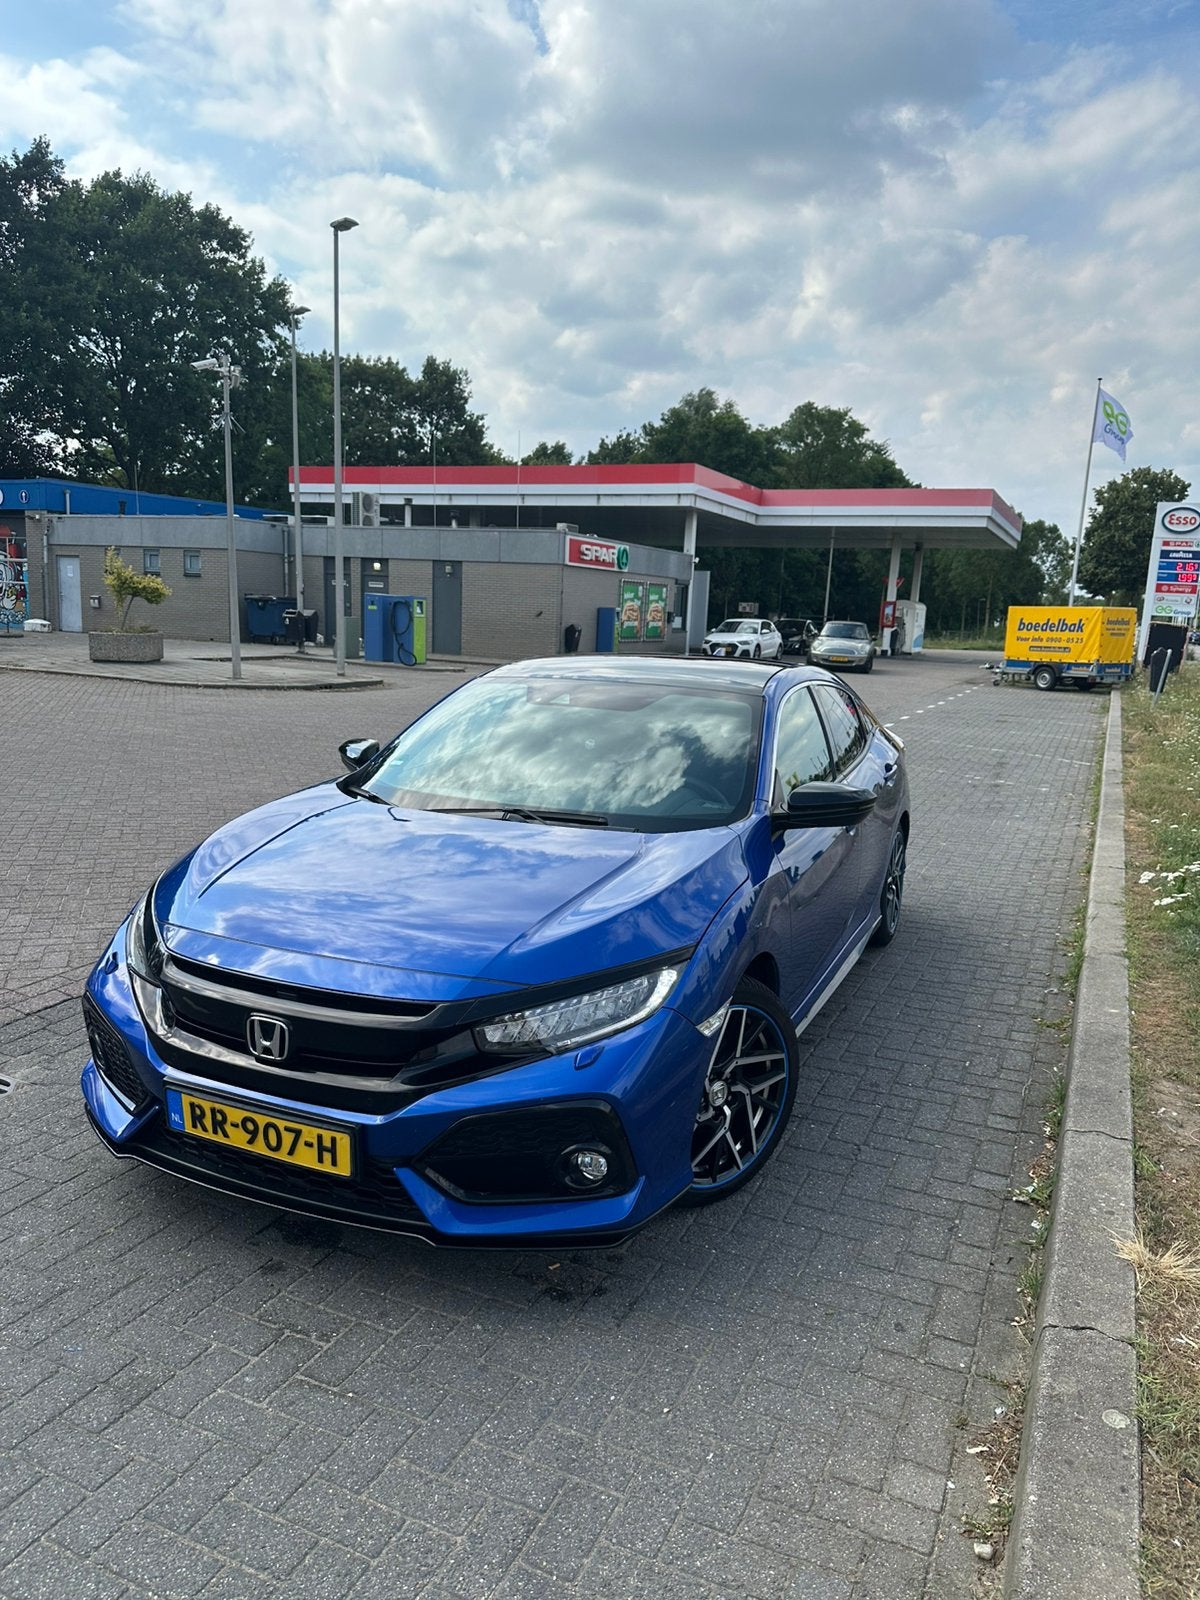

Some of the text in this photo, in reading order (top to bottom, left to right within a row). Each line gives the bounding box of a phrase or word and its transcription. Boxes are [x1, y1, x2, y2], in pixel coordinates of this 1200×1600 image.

[1168, 513, 1197, 526] Esso
[580, 544, 618, 563] SPAR
[1017, 617, 1085, 633] boedelbak
[171, 1112, 183, 1124] NL
[188, 1101, 339, 1167] RR-907-H
